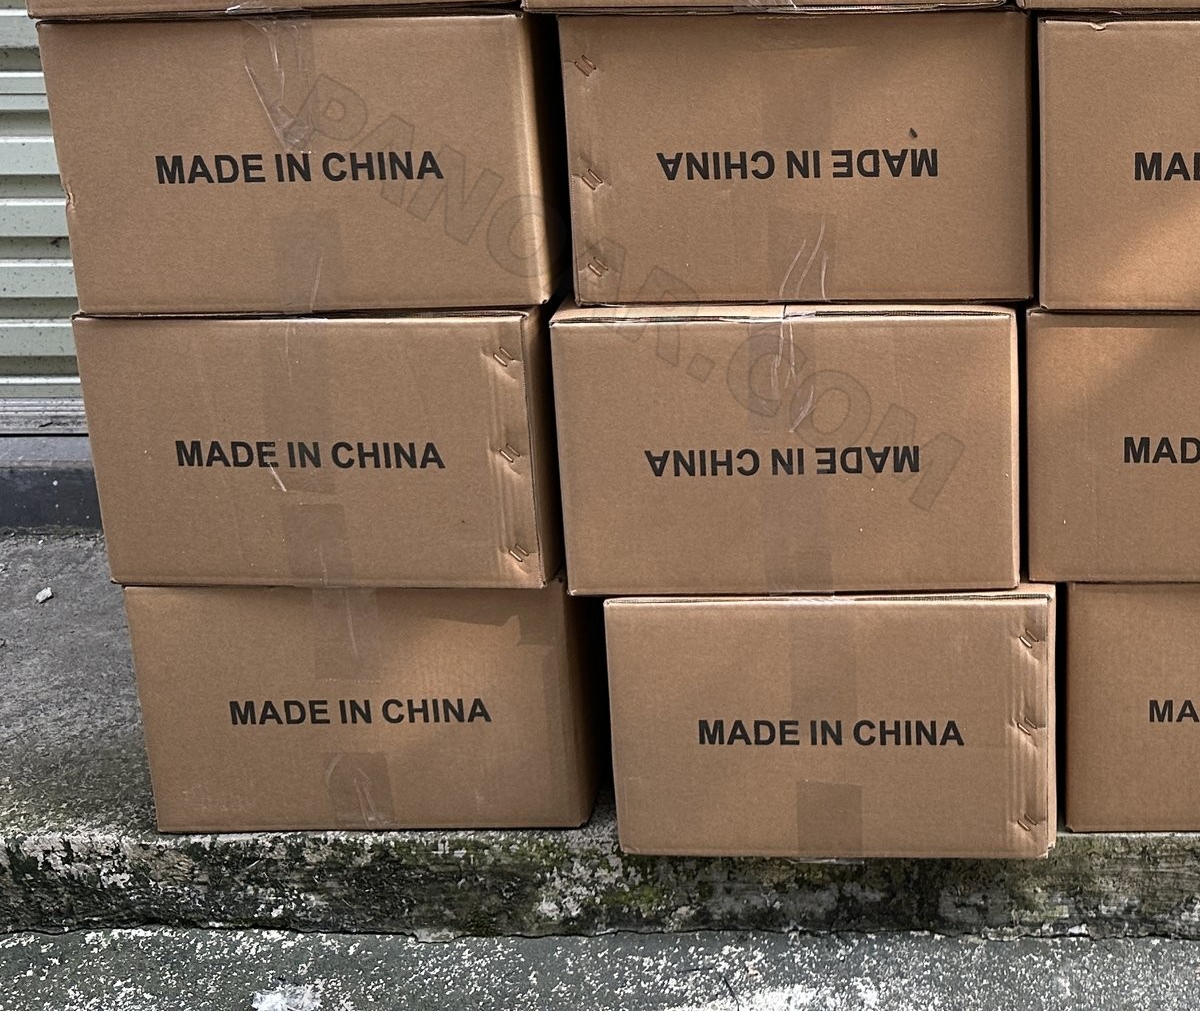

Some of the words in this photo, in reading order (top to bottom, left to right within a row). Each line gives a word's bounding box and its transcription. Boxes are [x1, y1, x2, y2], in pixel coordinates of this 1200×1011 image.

[156, 154, 266, 184] MADE
[275, 153, 311, 182] IN
[323, 151, 444, 181] CHINA
[656, 151, 775, 180] CHINA
[786, 150, 820, 178] IN
[831, 149, 938, 178] MADE
[175, 441, 279, 467] MADE
[287, 442, 321, 468] IN
[332, 442, 445, 468] CHINA
[644, 449, 759, 477] CHINA
[772, 448, 804, 475] IN
[815, 446, 919, 474] MADE
[230, 700, 330, 725] MADE
[339, 700, 372, 724] IN
[382, 698, 491, 723] CHINA
[699, 720, 800, 745] MADE
[810, 720, 842, 745] IN
[853, 720, 964, 746] CHINA
